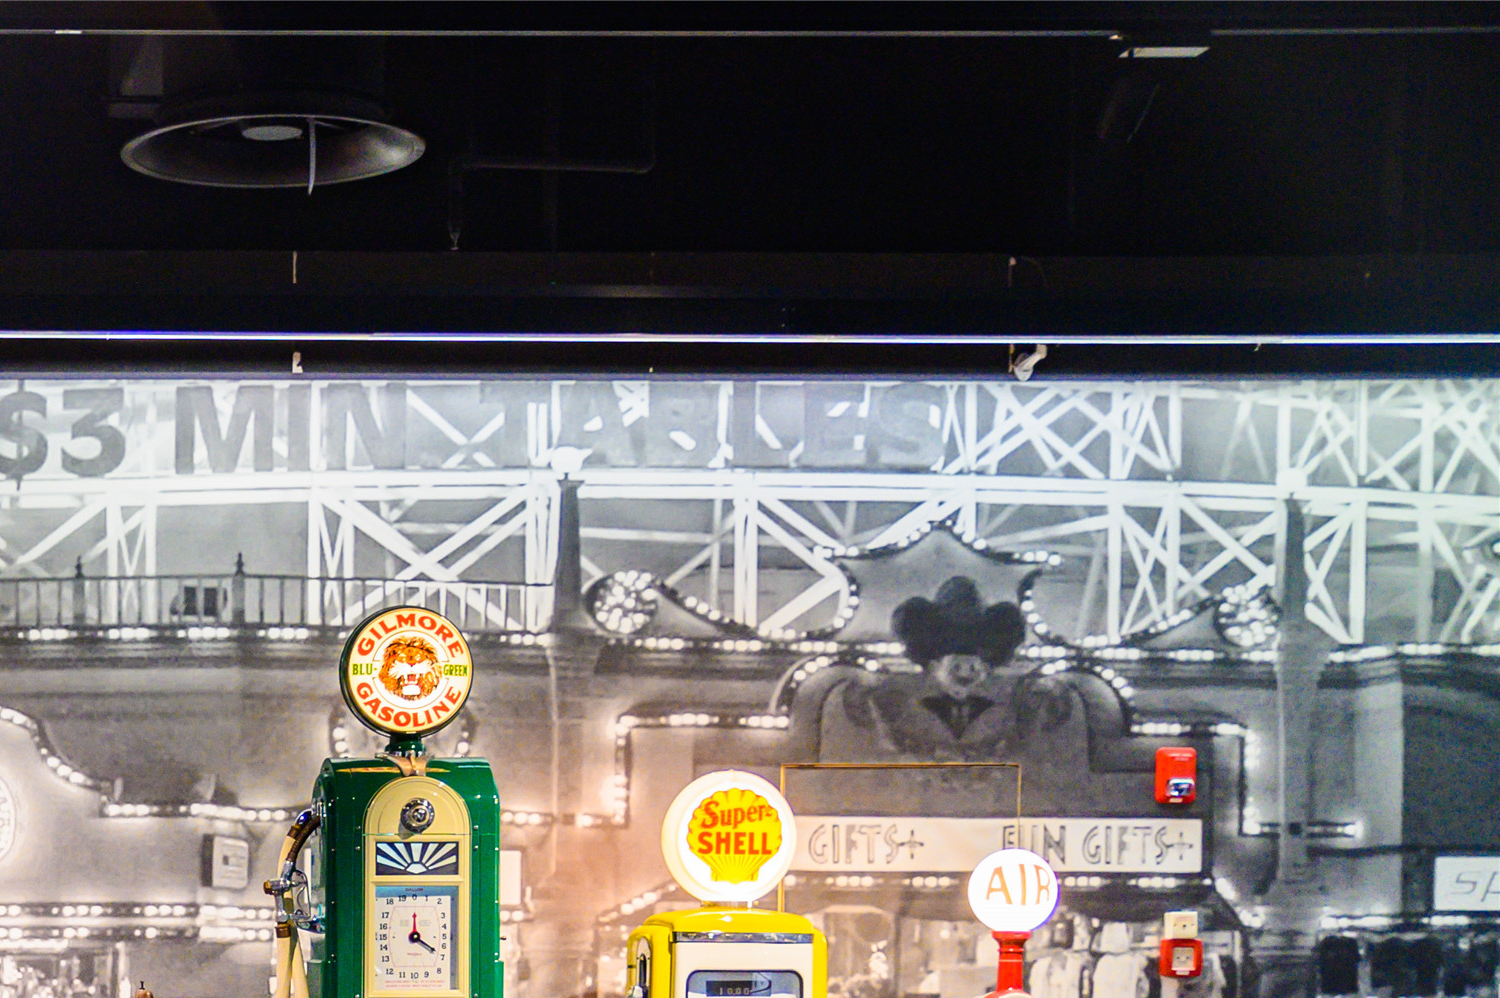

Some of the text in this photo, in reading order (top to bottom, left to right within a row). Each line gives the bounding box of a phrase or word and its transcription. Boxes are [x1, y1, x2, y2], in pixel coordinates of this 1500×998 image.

[175, 383, 407, 475] MIN
[357, 613, 464, 658] GILMORE
[443, 664, 468, 677] GREEN
[356, 682, 462, 728] GASOLINE
[698, 831, 772, 855] SHELL
[986, 863, 1051, 906] AIR
